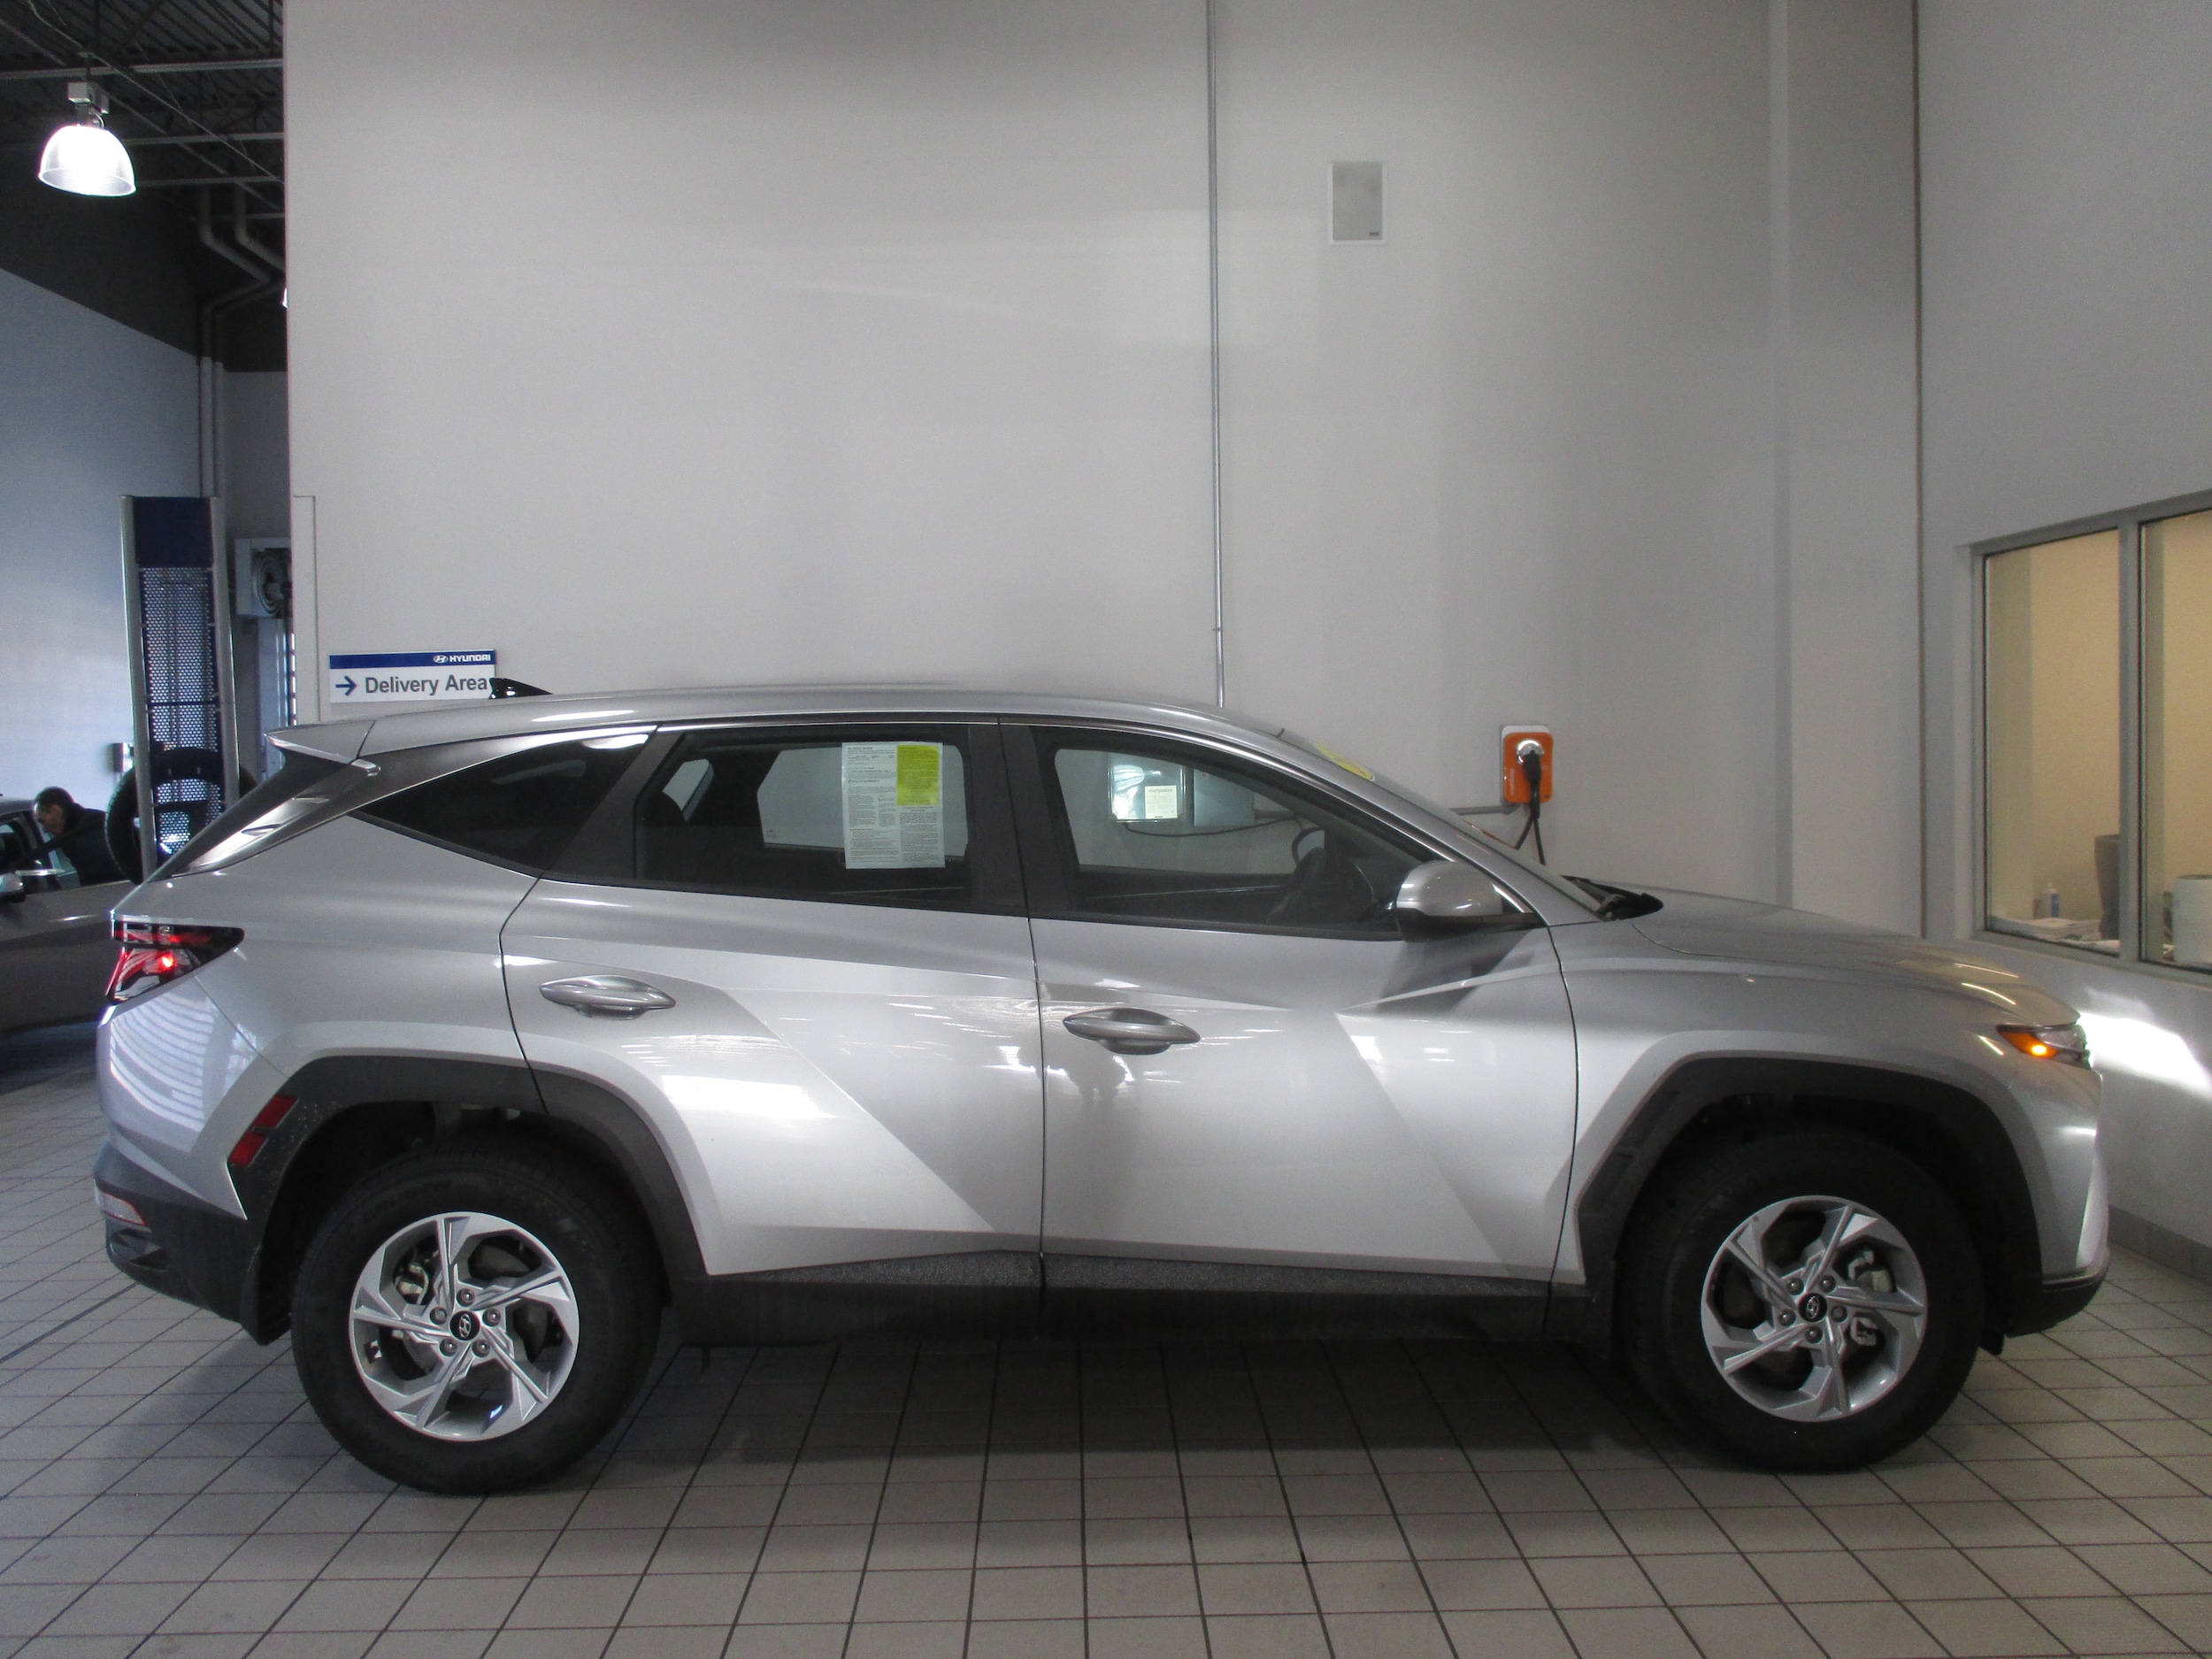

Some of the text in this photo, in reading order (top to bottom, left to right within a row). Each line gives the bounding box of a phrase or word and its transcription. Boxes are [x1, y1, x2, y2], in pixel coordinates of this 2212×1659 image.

[449, 654, 491, 663] HYUNDAI
[365, 674, 488, 696] Delivery Area
